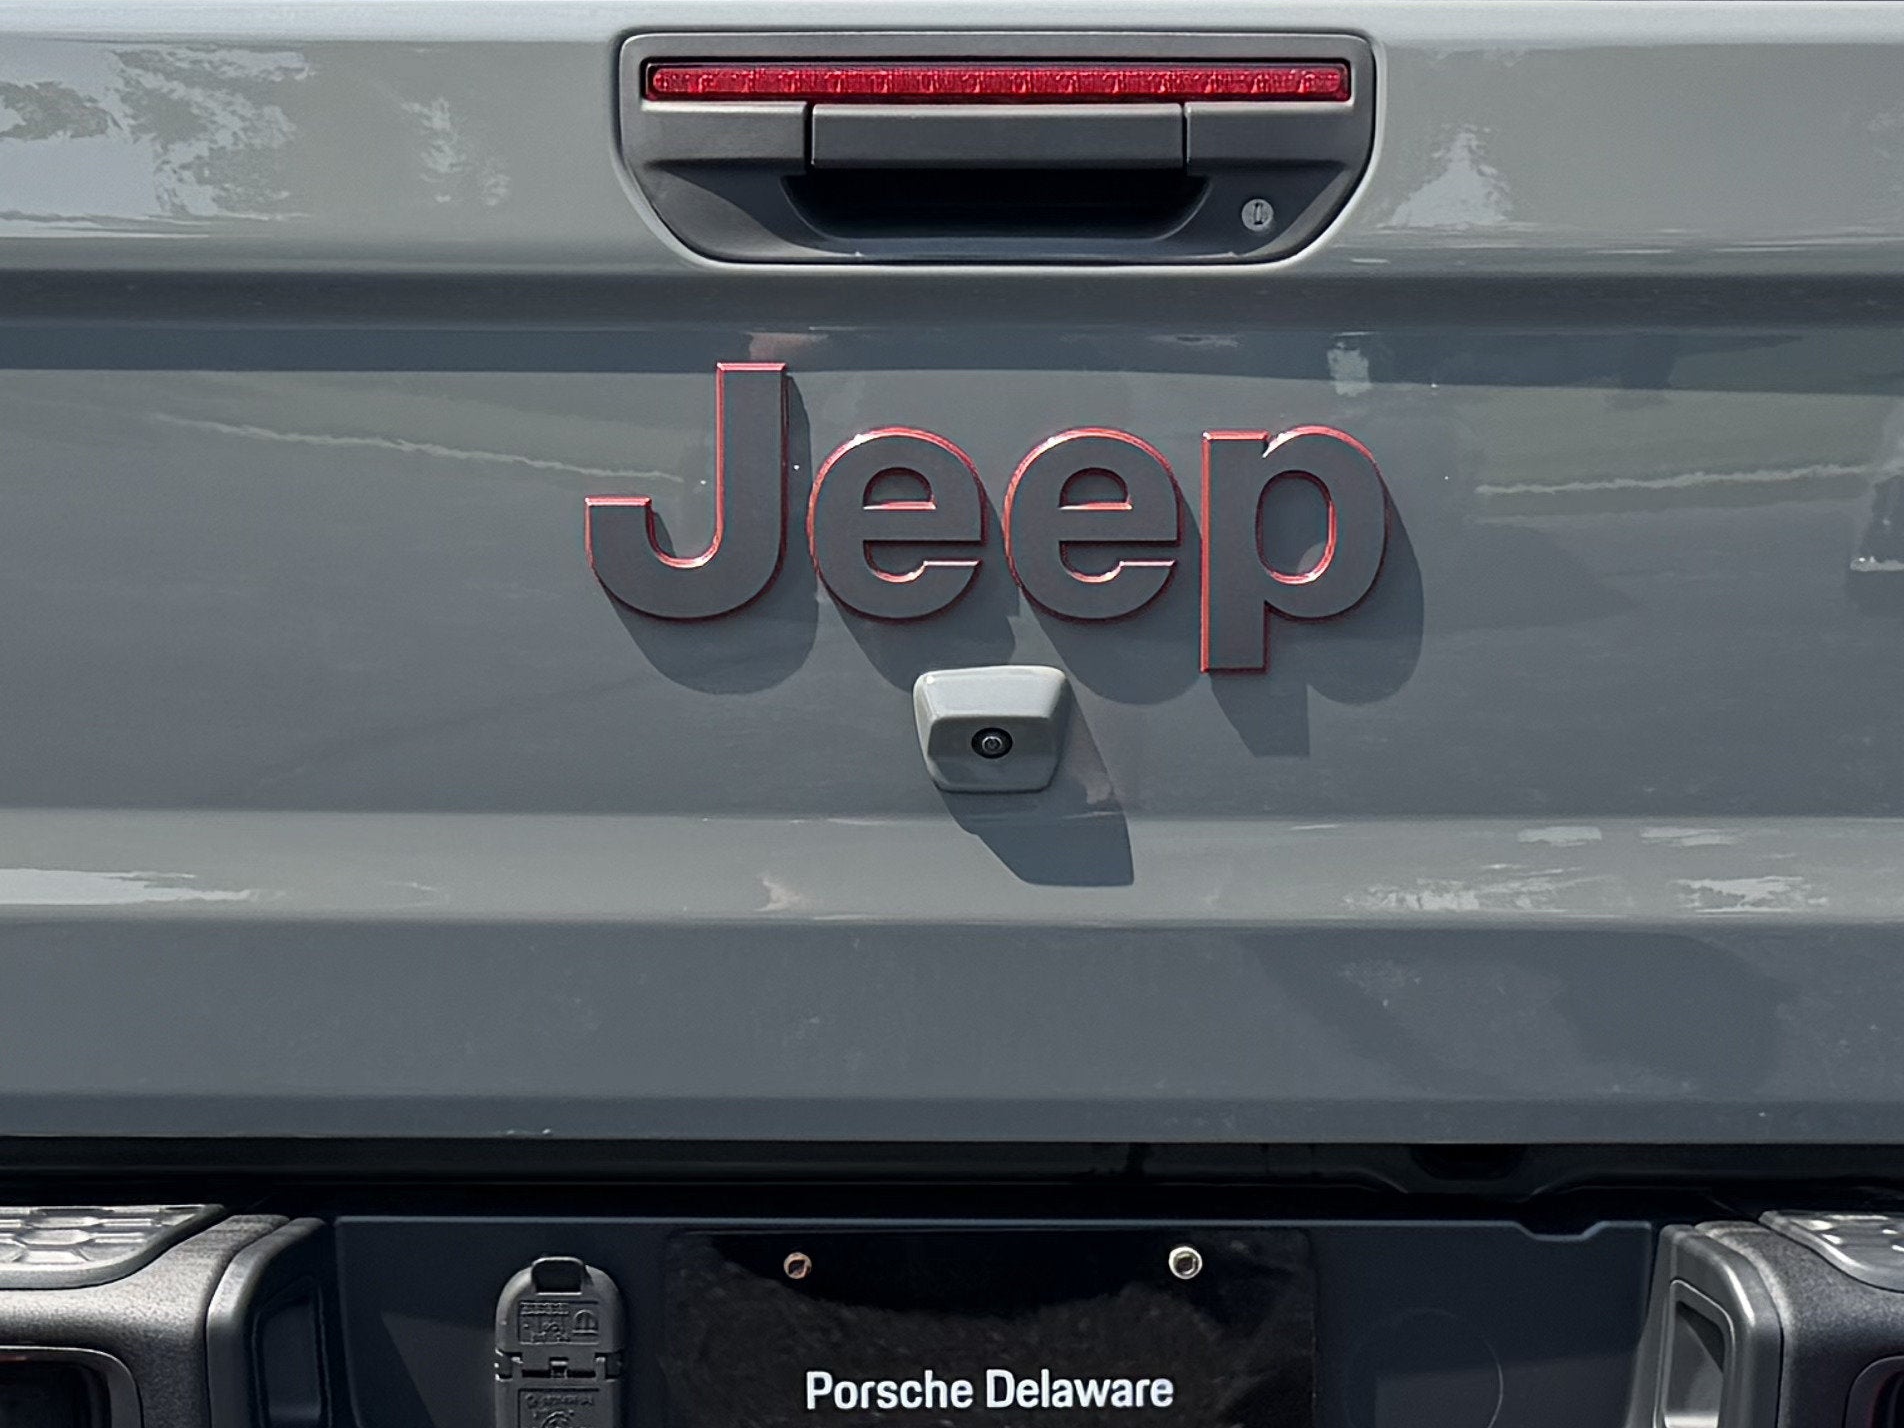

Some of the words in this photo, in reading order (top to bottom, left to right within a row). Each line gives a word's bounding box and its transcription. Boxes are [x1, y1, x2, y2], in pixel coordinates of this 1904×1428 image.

[584, 362, 1389, 675] Jeep
[805, 1369, 974, 1410] Porsche
[985, 1368, 1175, 1409] Delaware
